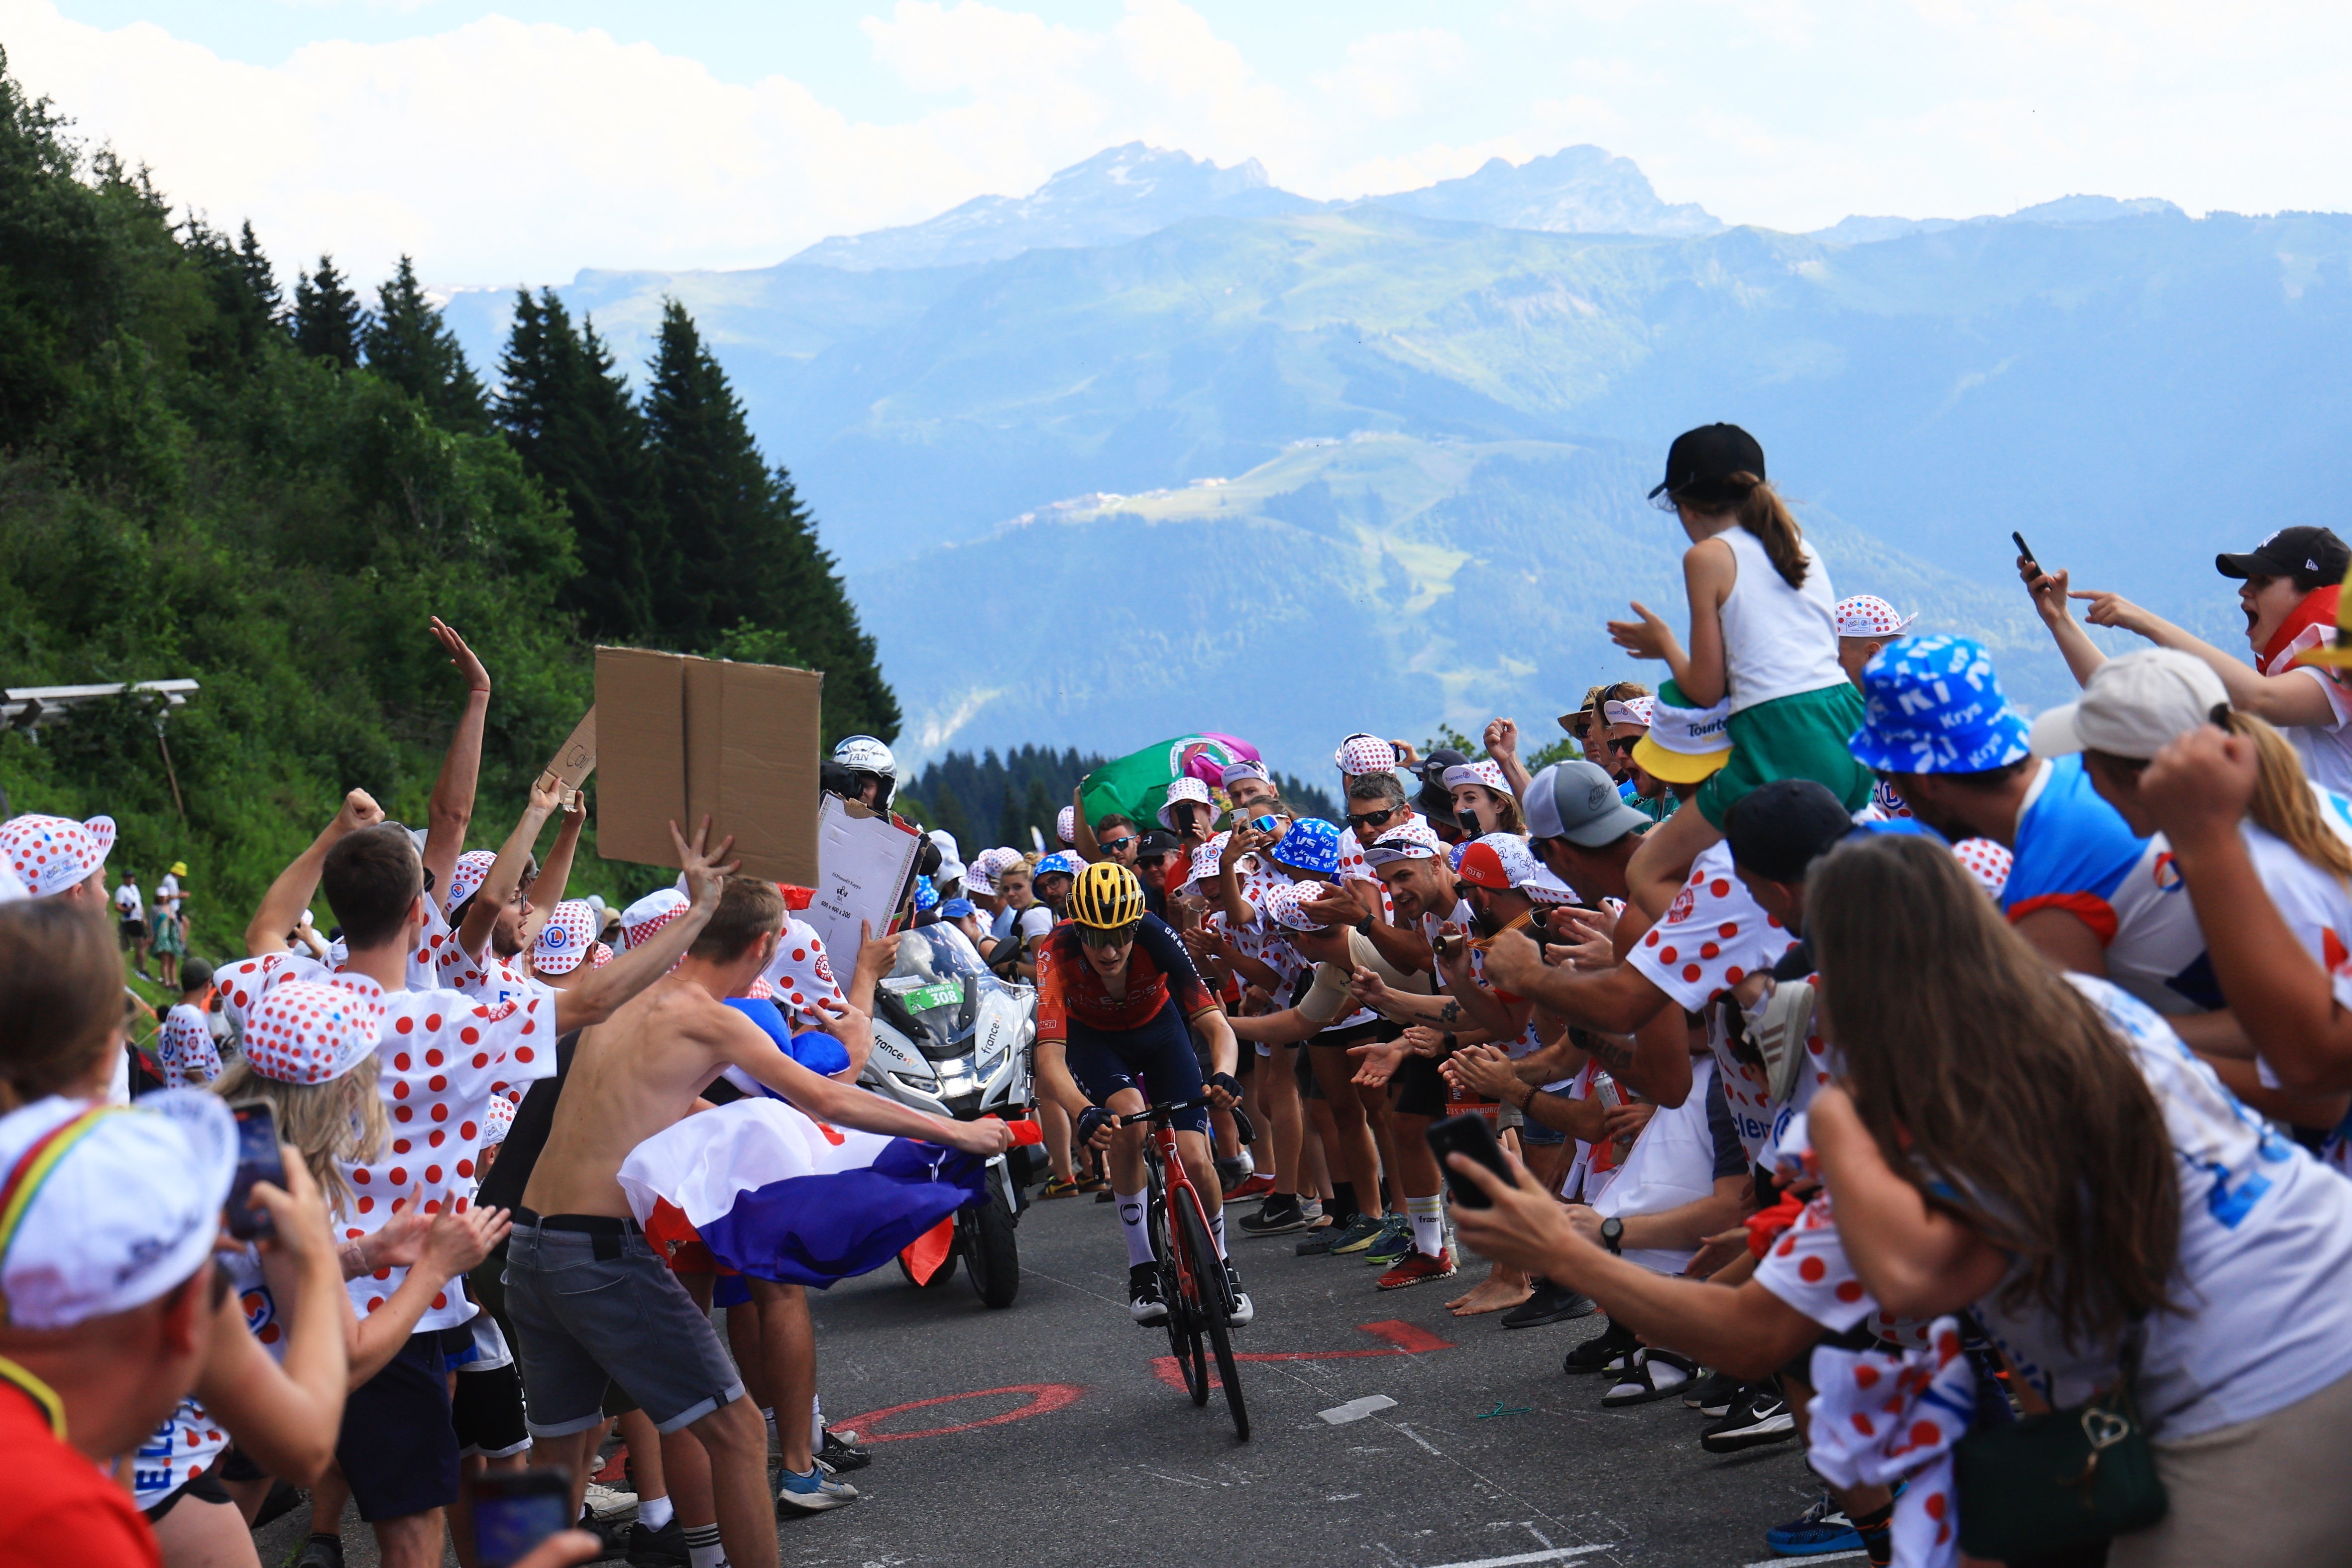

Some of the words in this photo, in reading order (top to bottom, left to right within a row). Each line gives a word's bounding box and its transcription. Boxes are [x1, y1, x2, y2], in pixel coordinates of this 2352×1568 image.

[1940, 702, 1983, 729] Krys
[1968, 732, 2002, 769] Krys
[848, 753, 870, 763] JAN
[1320, 835, 1335, 847] Krys
[1279, 846, 1291, 860] Krys
[1323, 859, 1338, 869] Krys
[842, 910, 851, 919] 200
[1036, 948, 1051, 1005] INEOS
[926, 985, 954, 994] RADIO-TV
[930, 990, 958, 1006] 308
